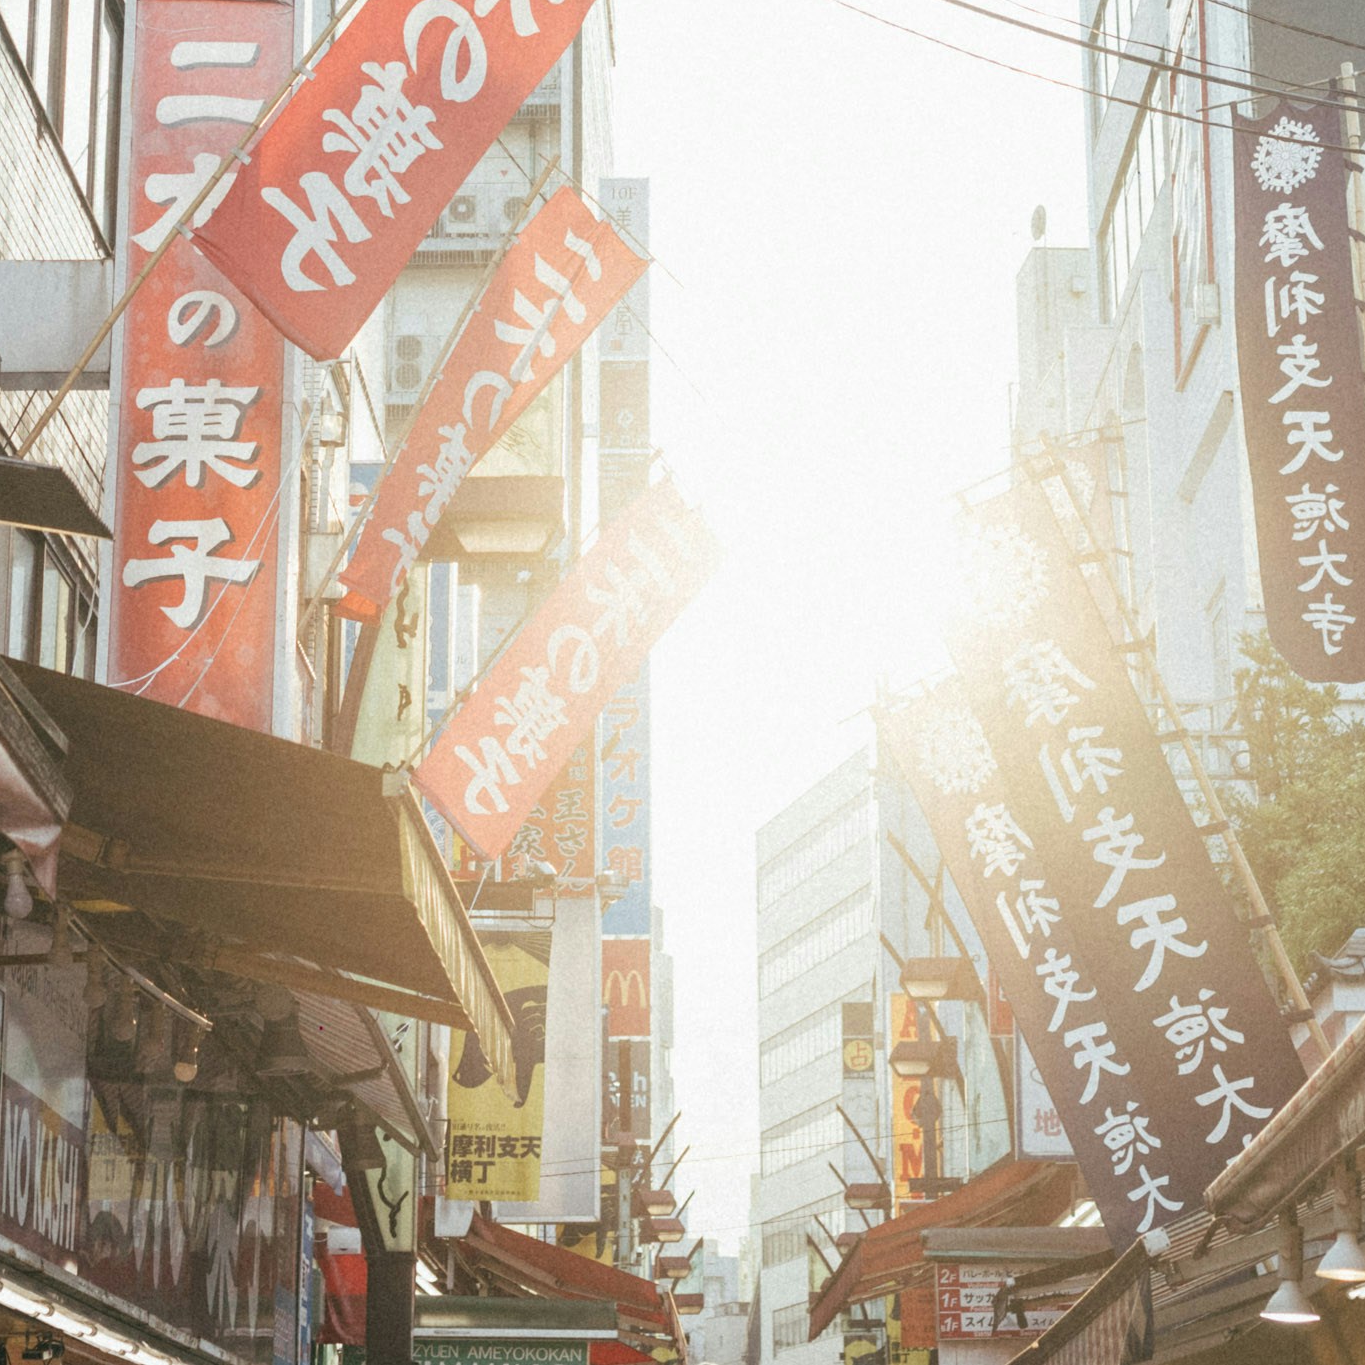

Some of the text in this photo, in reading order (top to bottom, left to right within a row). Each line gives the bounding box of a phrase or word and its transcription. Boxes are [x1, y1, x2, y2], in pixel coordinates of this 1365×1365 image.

[122, 40, 264, 629] 二木の菓子
[605, 672, 644, 882] ラオケ館
[850, 1041, 869, 1068] 占
[451, 1134, 542, 1160] 摩利支天
[1, 1099, 32, 1227] NO
[33, 1119, 81, 1252] KASHI
[450, 1160, 496, 1184] 横丁
[940, 1268, 957, 1283] 2F
[941, 1293, 958, 1308] 1F
[466, 1345, 583, 1362] AMEYOKOKAN
